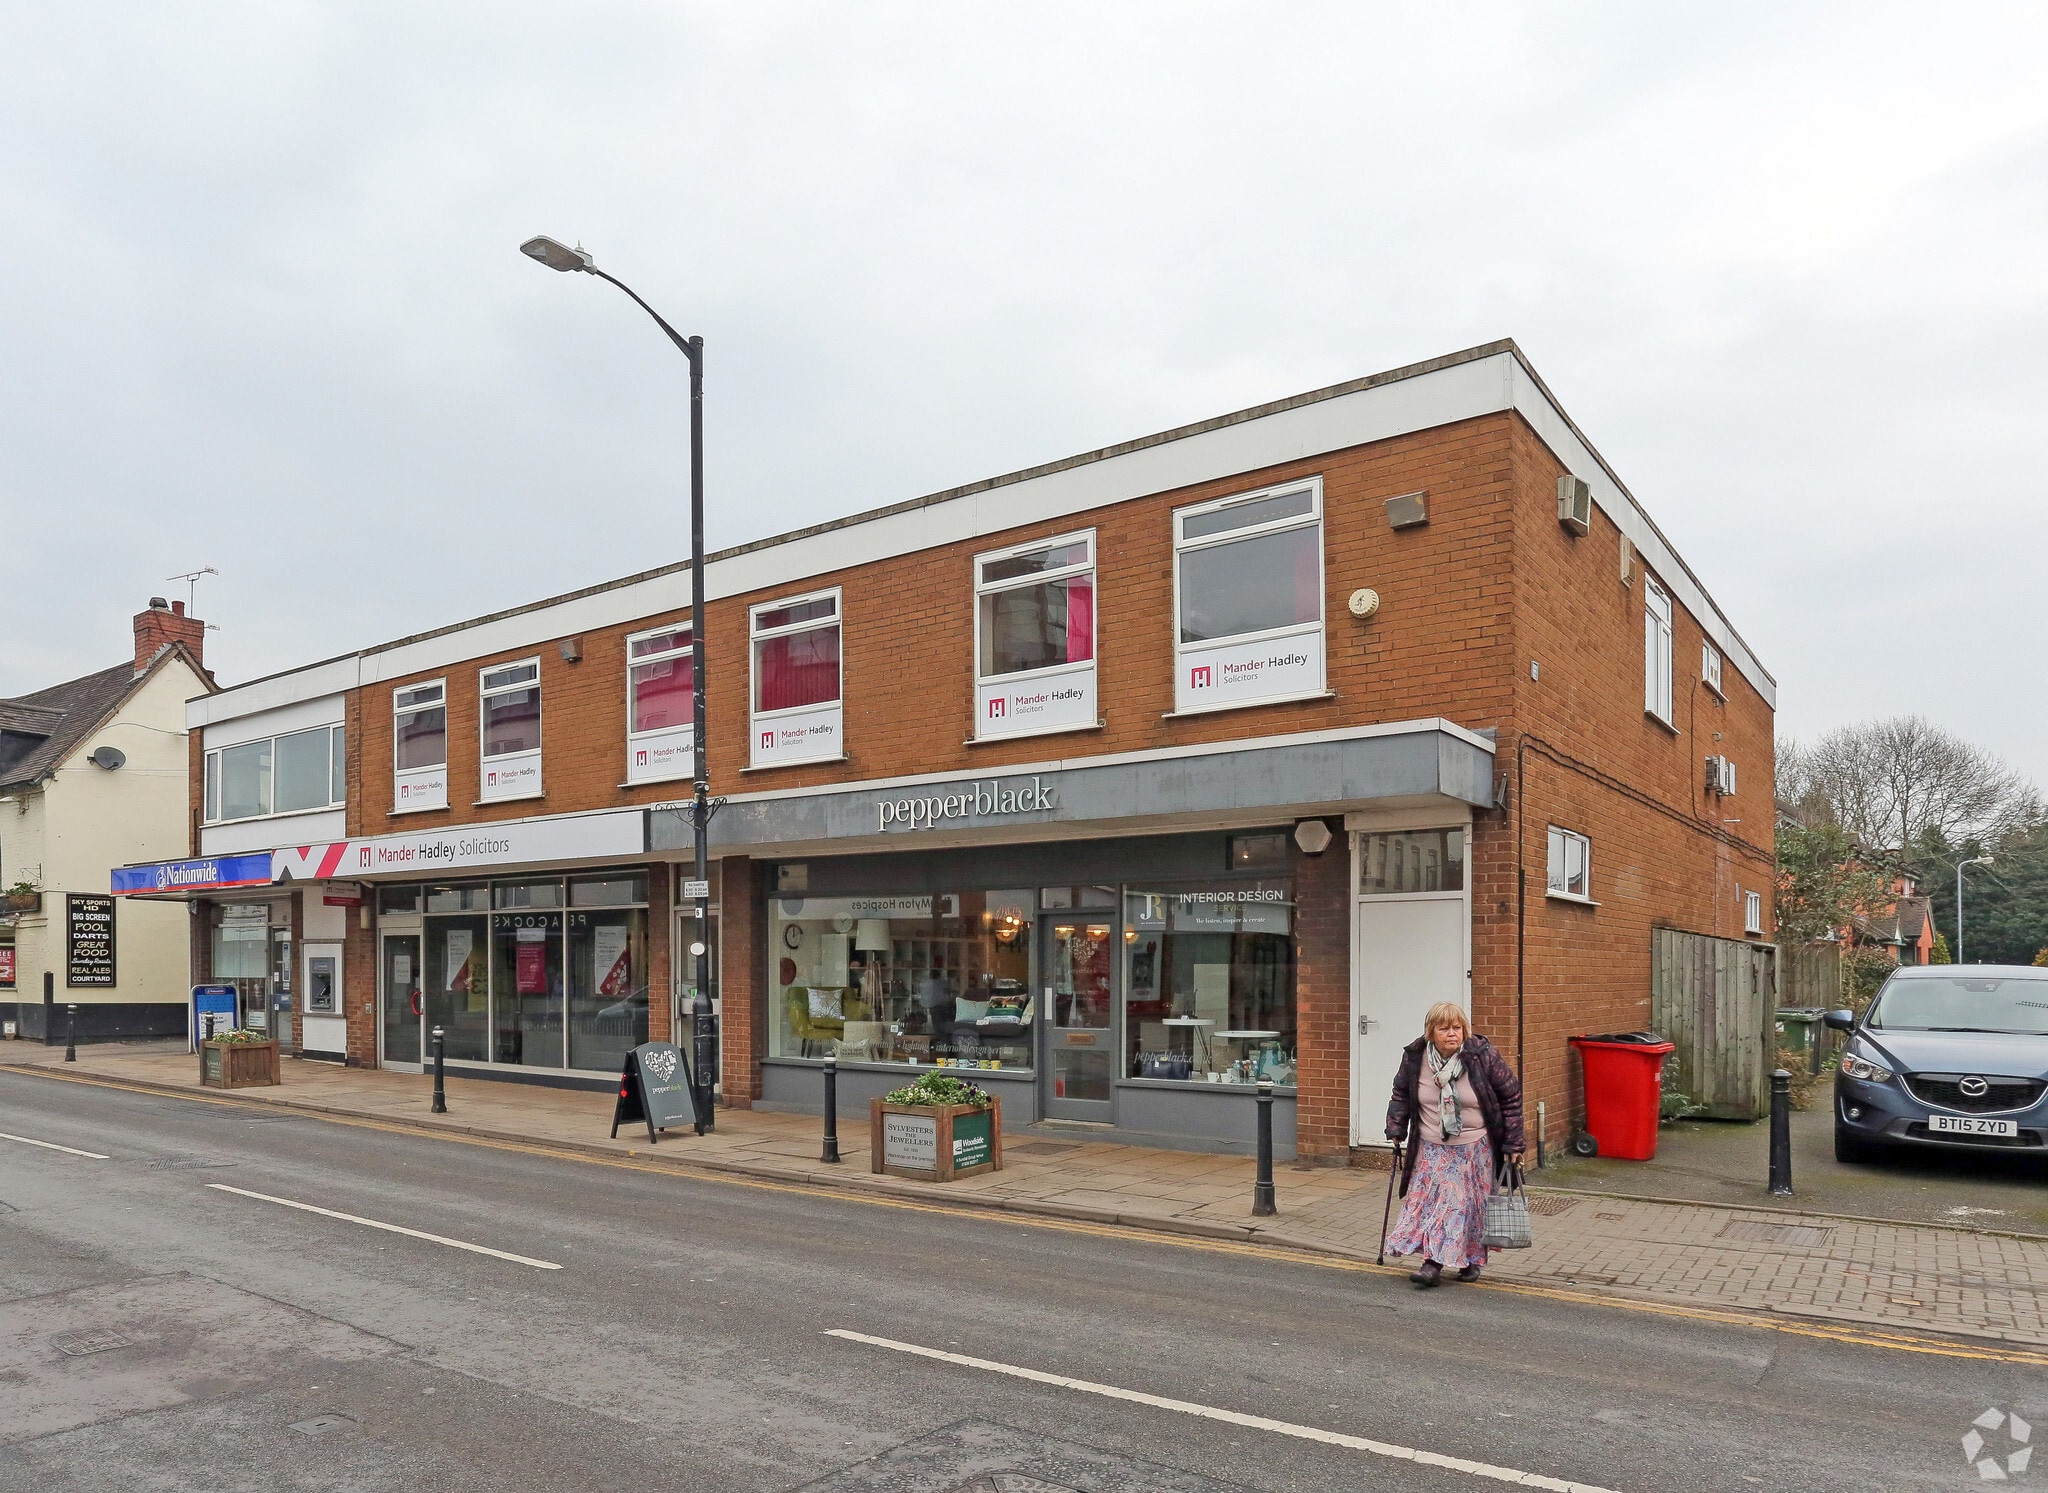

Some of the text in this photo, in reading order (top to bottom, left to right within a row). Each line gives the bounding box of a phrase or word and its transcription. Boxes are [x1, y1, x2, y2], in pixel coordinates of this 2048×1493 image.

[1223, 652, 1308, 674] Mander Hadley
[1223, 672, 1259, 684] Solicitors
[1015, 688, 1084, 706] Mander Hadley
[1015, 704, 1044, 715] Solicitors
[781, 725, 834, 739] Mander Hadley
[781, 738, 803, 747] Solicitors
[653, 744, 694, 757] Mander Hadle
[501, 765, 536, 779] Mander Hadley
[428, 781, 443, 790] Hadley
[877, 776, 1053, 832] pepperblack
[378, 837, 510, 863] Mander Hadley Solicitors
[166, 862, 217, 885] Nationwide
[1179, 889, 1284, 904] INTERIOR DESIGN
[1213, 904, 1247, 912] SERVICE
[72, 912, 110, 921] BIG SCREEN
[75, 923, 107, 932] POOL
[76, 941, 106, 949] GREAT
[887, 1123, 934, 1135] SYLVESTERS
[1938, 1118, 2007, 1133] BT15 ZYD
[888, 1135, 934, 1147] JEWELLERS
